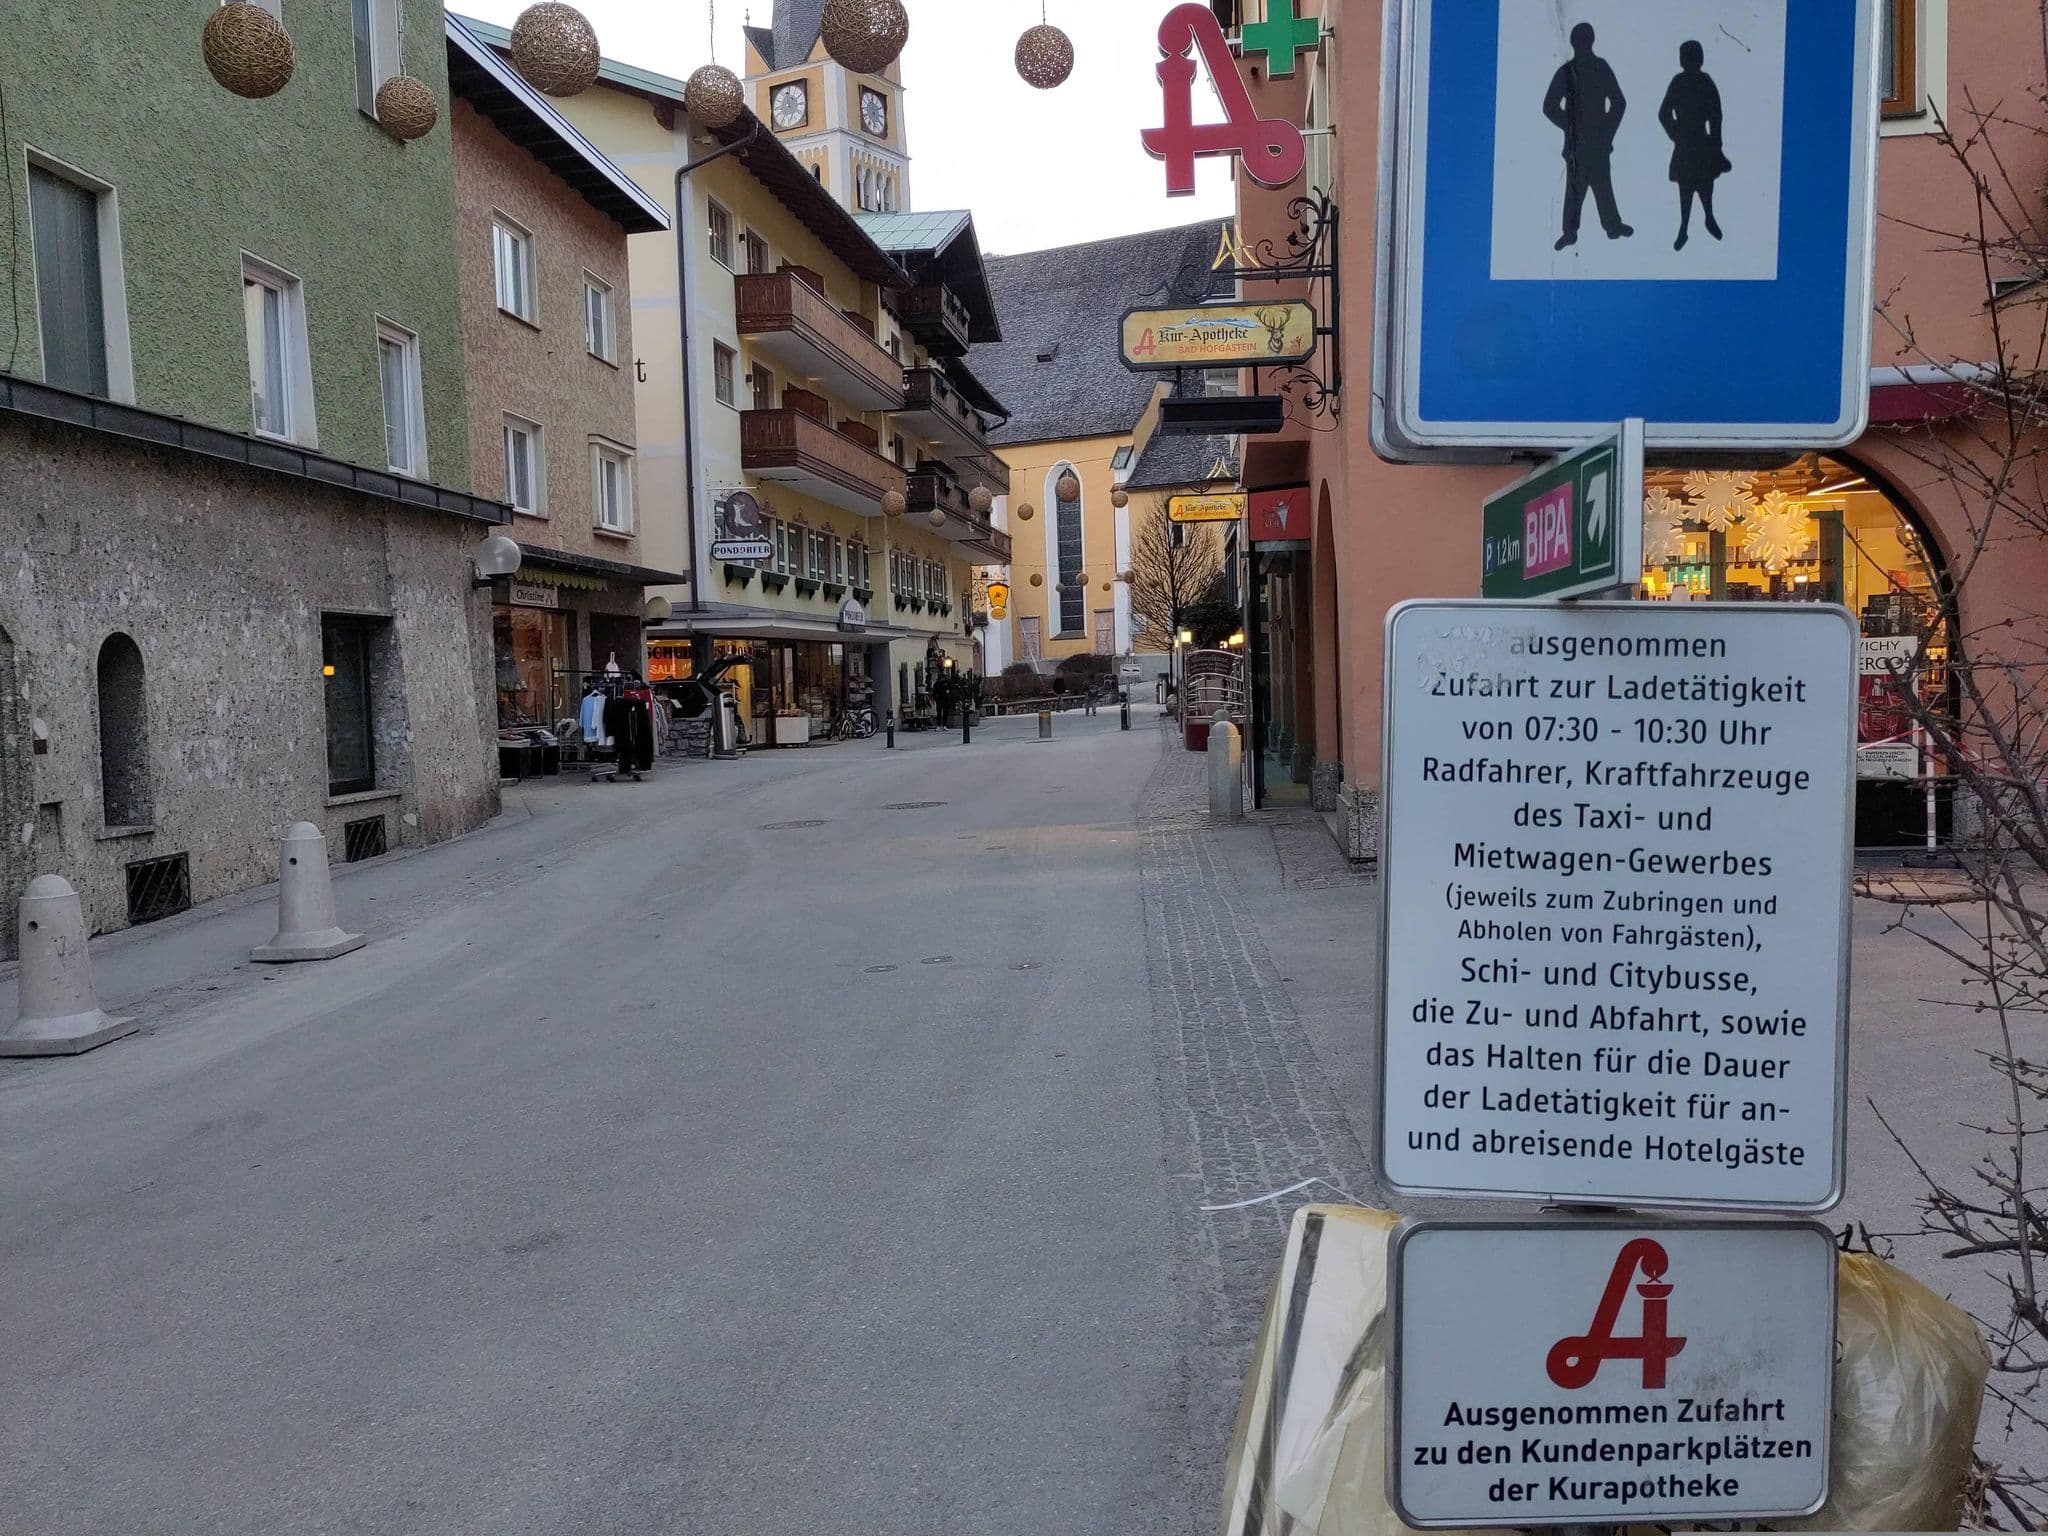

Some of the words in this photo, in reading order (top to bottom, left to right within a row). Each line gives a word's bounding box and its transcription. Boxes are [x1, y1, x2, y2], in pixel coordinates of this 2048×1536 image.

[1158, 327, 1248, 345] Kur-Apotheke
[1178, 345, 1197, 354] BAD
[1199, 343, 1257, 353] HOFGASTEIN
[714, 545, 770, 554] PONDORFER
[1527, 498, 1568, 569] BIPA
[516, 589, 545, 601] Christine
[1510, 633, 1727, 661] ausgenommen
[1431, 671, 1540, 698] Zufahrt
[1550, 679, 1597, 699] zur
[1607, 674, 1807, 707] Ladetätigkeit
[1462, 720, 1513, 741] von
[1525, 715, 1599, 743] 07:30
[1633, 717, 1707, 745] 10:30
[1719, 719, 1773, 746] Uhr
[1423, 756, 1573, 789] Radfahrer,
[1585, 760, 1810, 795] Kraftfahrzeuge
[1513, 801, 1563, 828] des
[1573, 802, 1646, 830] Taxi-
[1658, 805, 1712, 832] und
[1454, 841, 1772, 877] Mietwagen-Gewerbes
[1445, 881, 1537, 911] (jeweils
[1545, 893, 1594, 910] zum
[1602, 889, 1723, 918] Zubringen
[1733, 894, 1777, 916] und
[1457, 918, 1552, 942] Abholen
[1560, 926, 1603, 944] von
[1612, 923, 1763, 952] Fahrgästen),
[1460, 956, 1532, 984] Schi-
[1544, 961, 1597, 987] und
[1609, 960, 1758, 996] Citybusse,
[1412, 996, 1455, 1025] die
[1465, 999, 1513, 1026] Zu-
[1525, 1003, 1578, 1029] und
[1588, 1004, 1709, 1037] Abfahrt,
[1721, 1008, 1807, 1037] sowie
[1426, 1041, 1475, 1068] das
[1487, 1042, 1582, 1072] Halten
[1592, 1046, 1637, 1074] für
[1647, 1048, 1691, 1076] die
[1703, 1051, 1791, 1080] Dauer
[1423, 1083, 1472, 1110] der
[1482, 1085, 1677, 1121] Ladetätigkeit
[1686, 1092, 1731, 1120] für
[1741, 1101, 1790, 1122] an-
[1408, 1126, 1460, 1152] und
[1471, 1128, 1633, 1160] abreisende
[1645, 1134, 1805, 1169] Hotelgäste
[1443, 1401, 1668, 1431] Ausgenommen
[1676, 1398, 1785, 1423] Zufahrt
[1413, 1446, 1448, 1466] zu
[1457, 1439, 1512, 1465] den
[1521, 1434, 1813, 1465] Kundenparkplätzen
[1488, 1477, 1540, 1503] der
[1548, 1473, 1739, 1505] Kurapotheke
